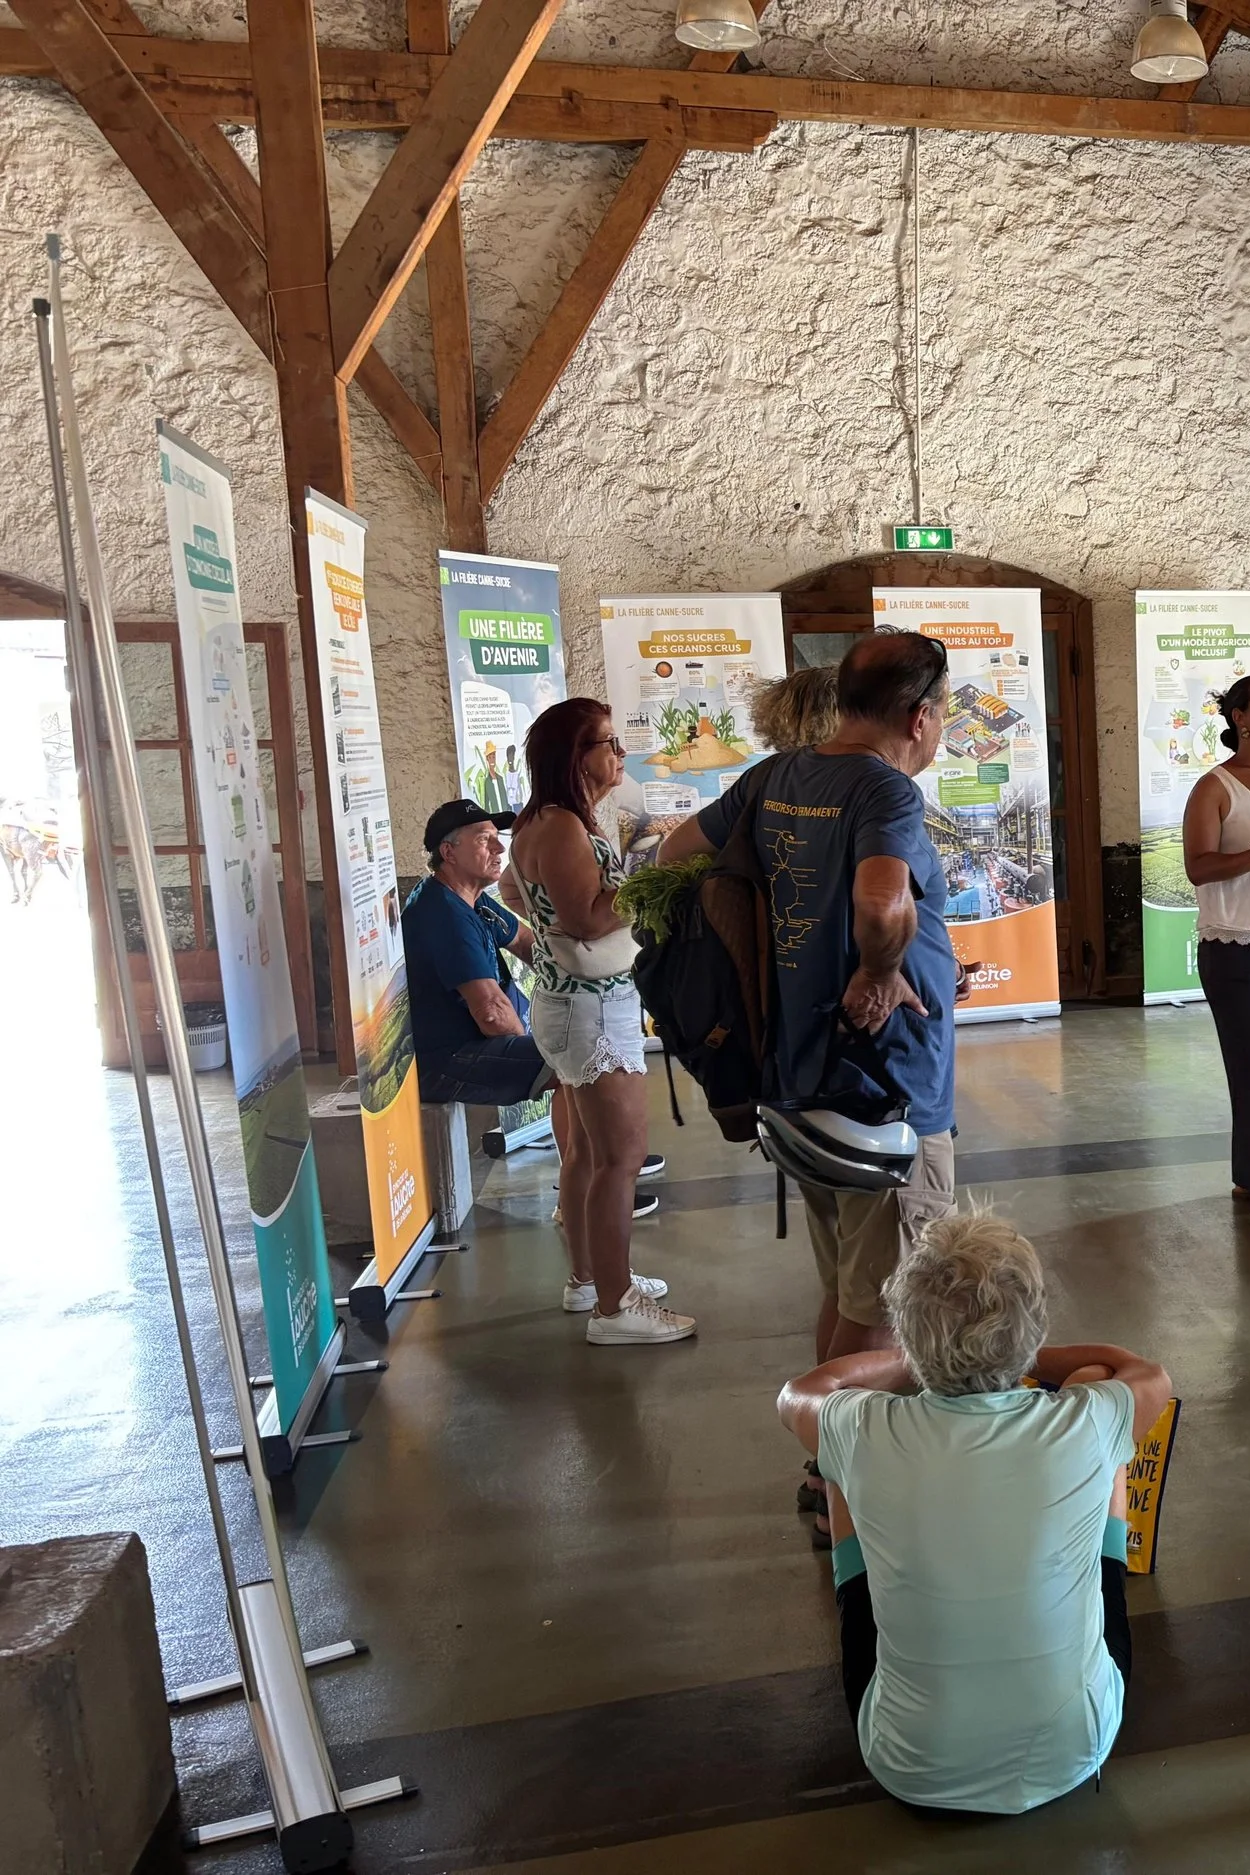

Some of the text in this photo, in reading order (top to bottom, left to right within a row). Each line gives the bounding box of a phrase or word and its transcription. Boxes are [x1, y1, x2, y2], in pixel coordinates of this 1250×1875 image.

[451, 571, 512, 588] LA FILIÈRE CANNE-SUCRE
[890, 599, 969, 609] LA FILIÈRE CANNE-SUCRE
[1158, 604, 1178, 612] FILIÈRE
[617, 606, 704, 617] LA FILIÈRE CANNE-SUCRE
[469, 617, 544, 640] UNE FILIÈRE
[924, 626, 995, 635] UNE INDUSTRIE
[663, 633, 726, 642] NOS SUCRES
[1182, 637, 1216, 646] MODÈLE
[649, 643, 742, 654] CES GRANDS CRUS
[1192, 649, 1228, 657] INCLUSIF
[481, 646, 539, 667] D'AVENIR
